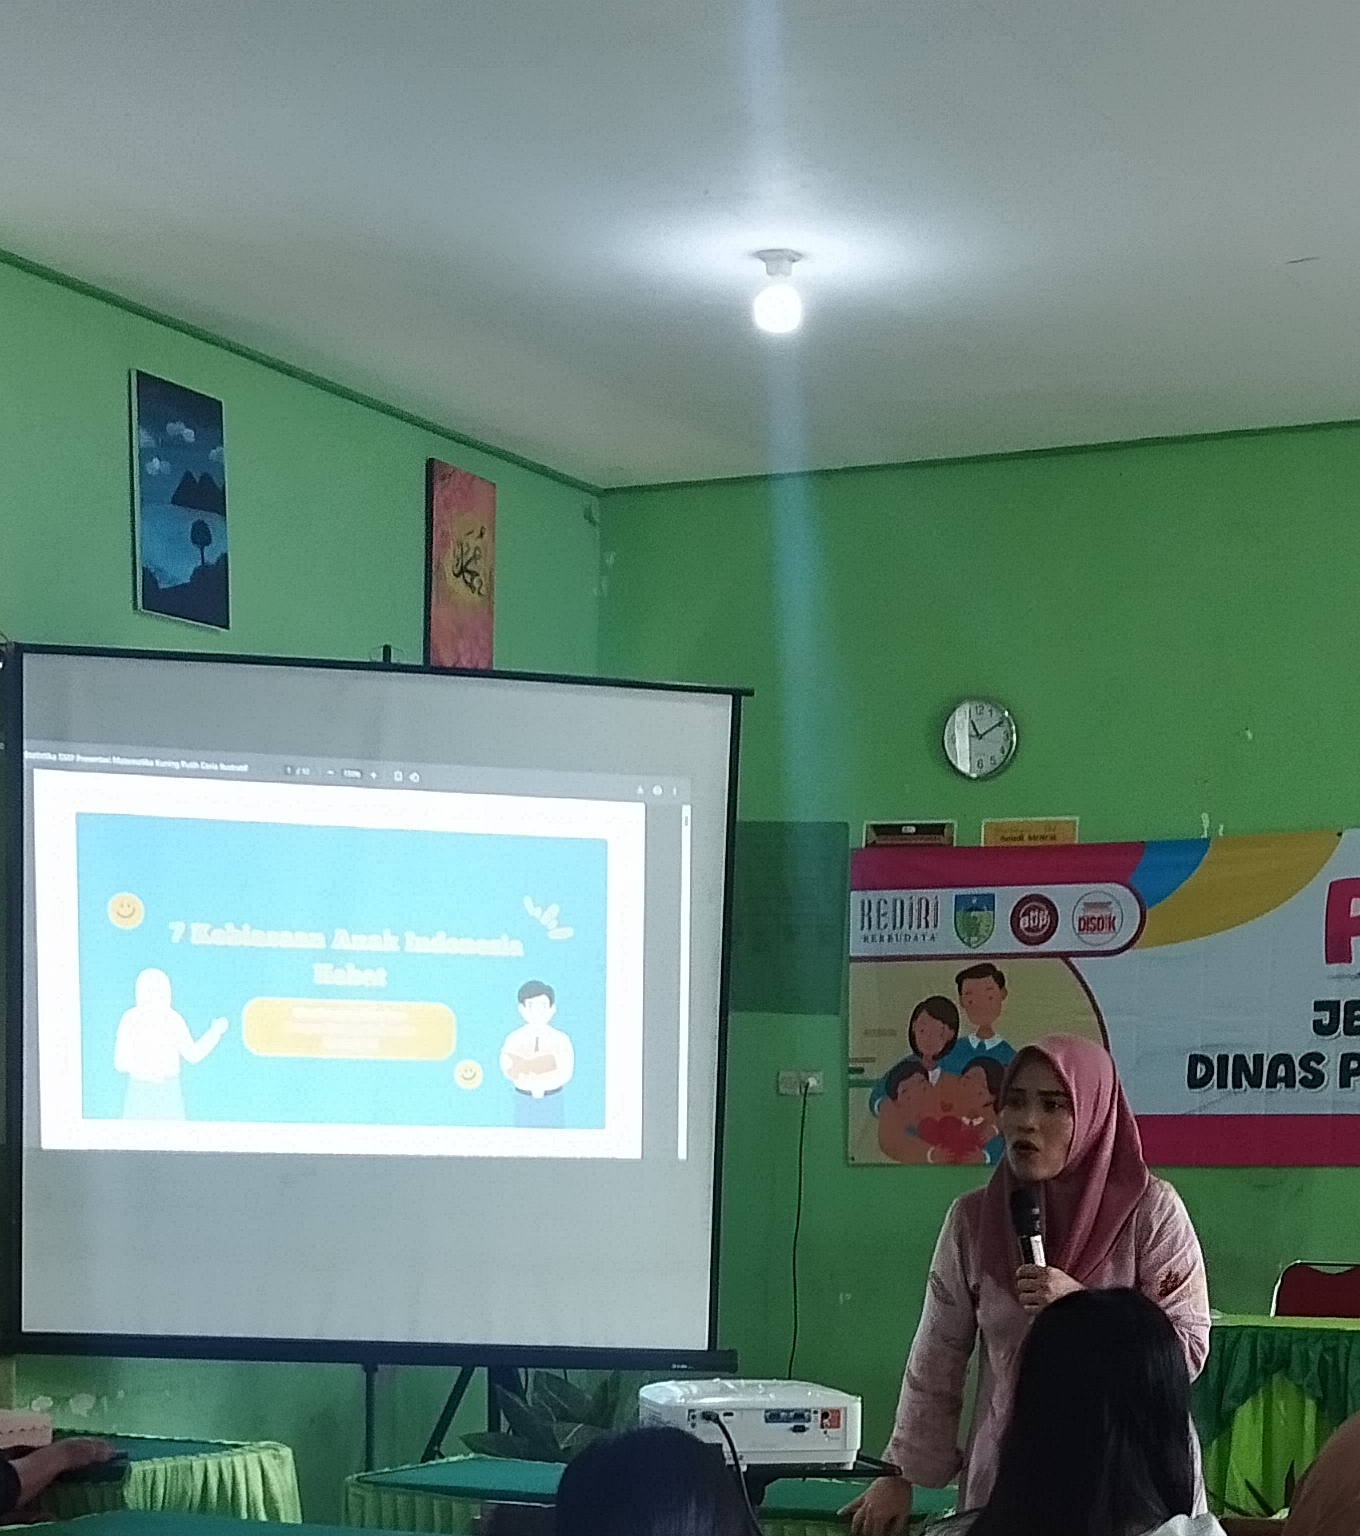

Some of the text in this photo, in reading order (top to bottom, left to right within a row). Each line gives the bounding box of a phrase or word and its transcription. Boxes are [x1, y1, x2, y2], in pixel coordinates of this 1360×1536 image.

[168, 921, 186, 944] 7
[1077, 914, 1117, 934] DISDIK
[1185, 1050, 1327, 1091] DINAS
